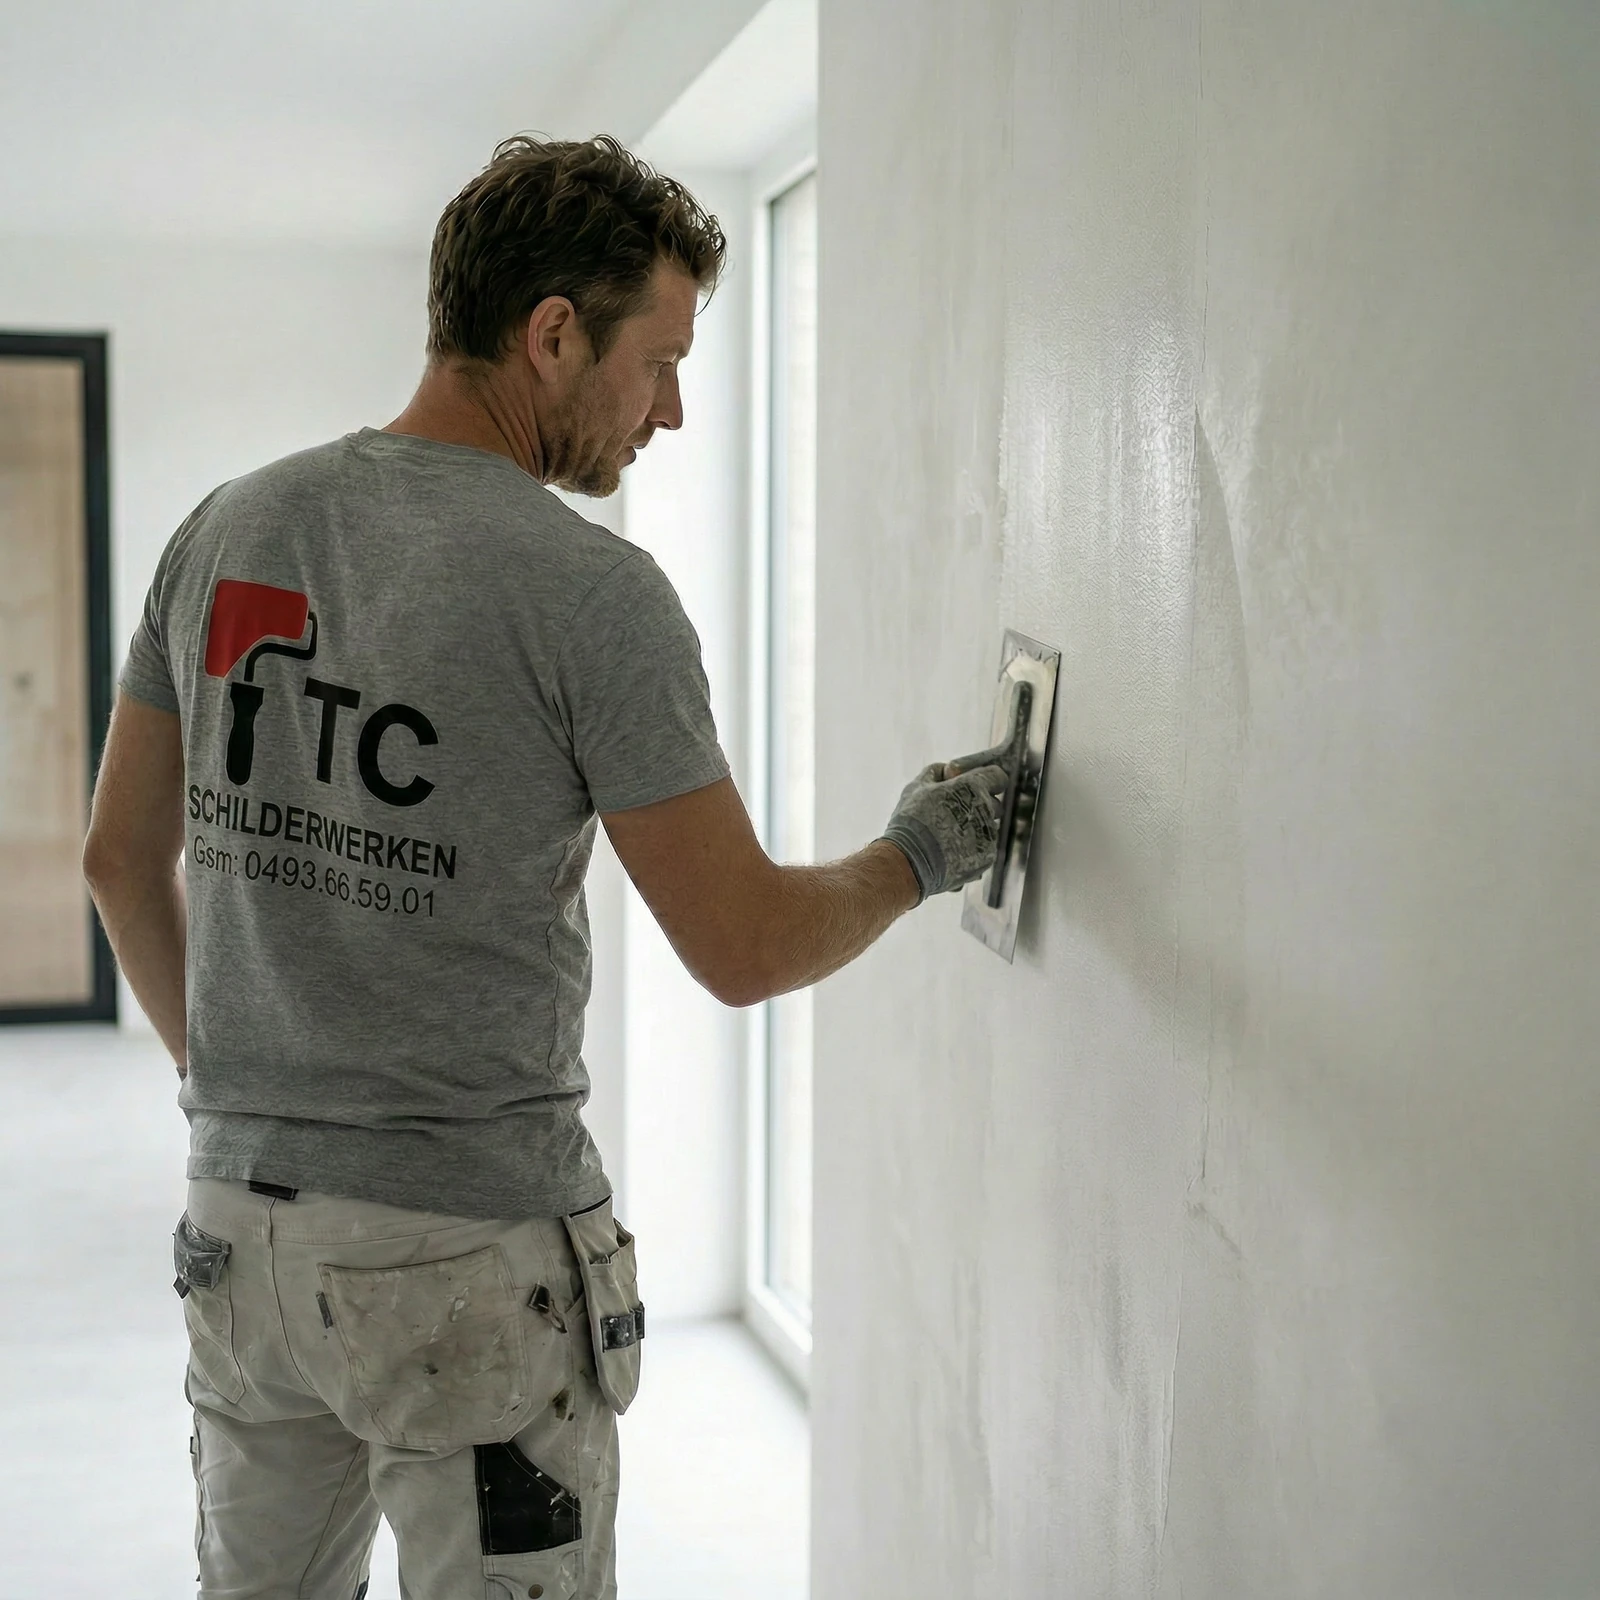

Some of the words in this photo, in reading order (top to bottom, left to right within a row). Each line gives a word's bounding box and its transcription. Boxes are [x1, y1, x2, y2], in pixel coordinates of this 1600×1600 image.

[304, 677, 439, 807] TC
[189, 784, 457, 880] SCHILDERWERKEN
[193, 835, 239, 877] Gsm:
[245, 850, 435, 918] 0493.66.59.01
